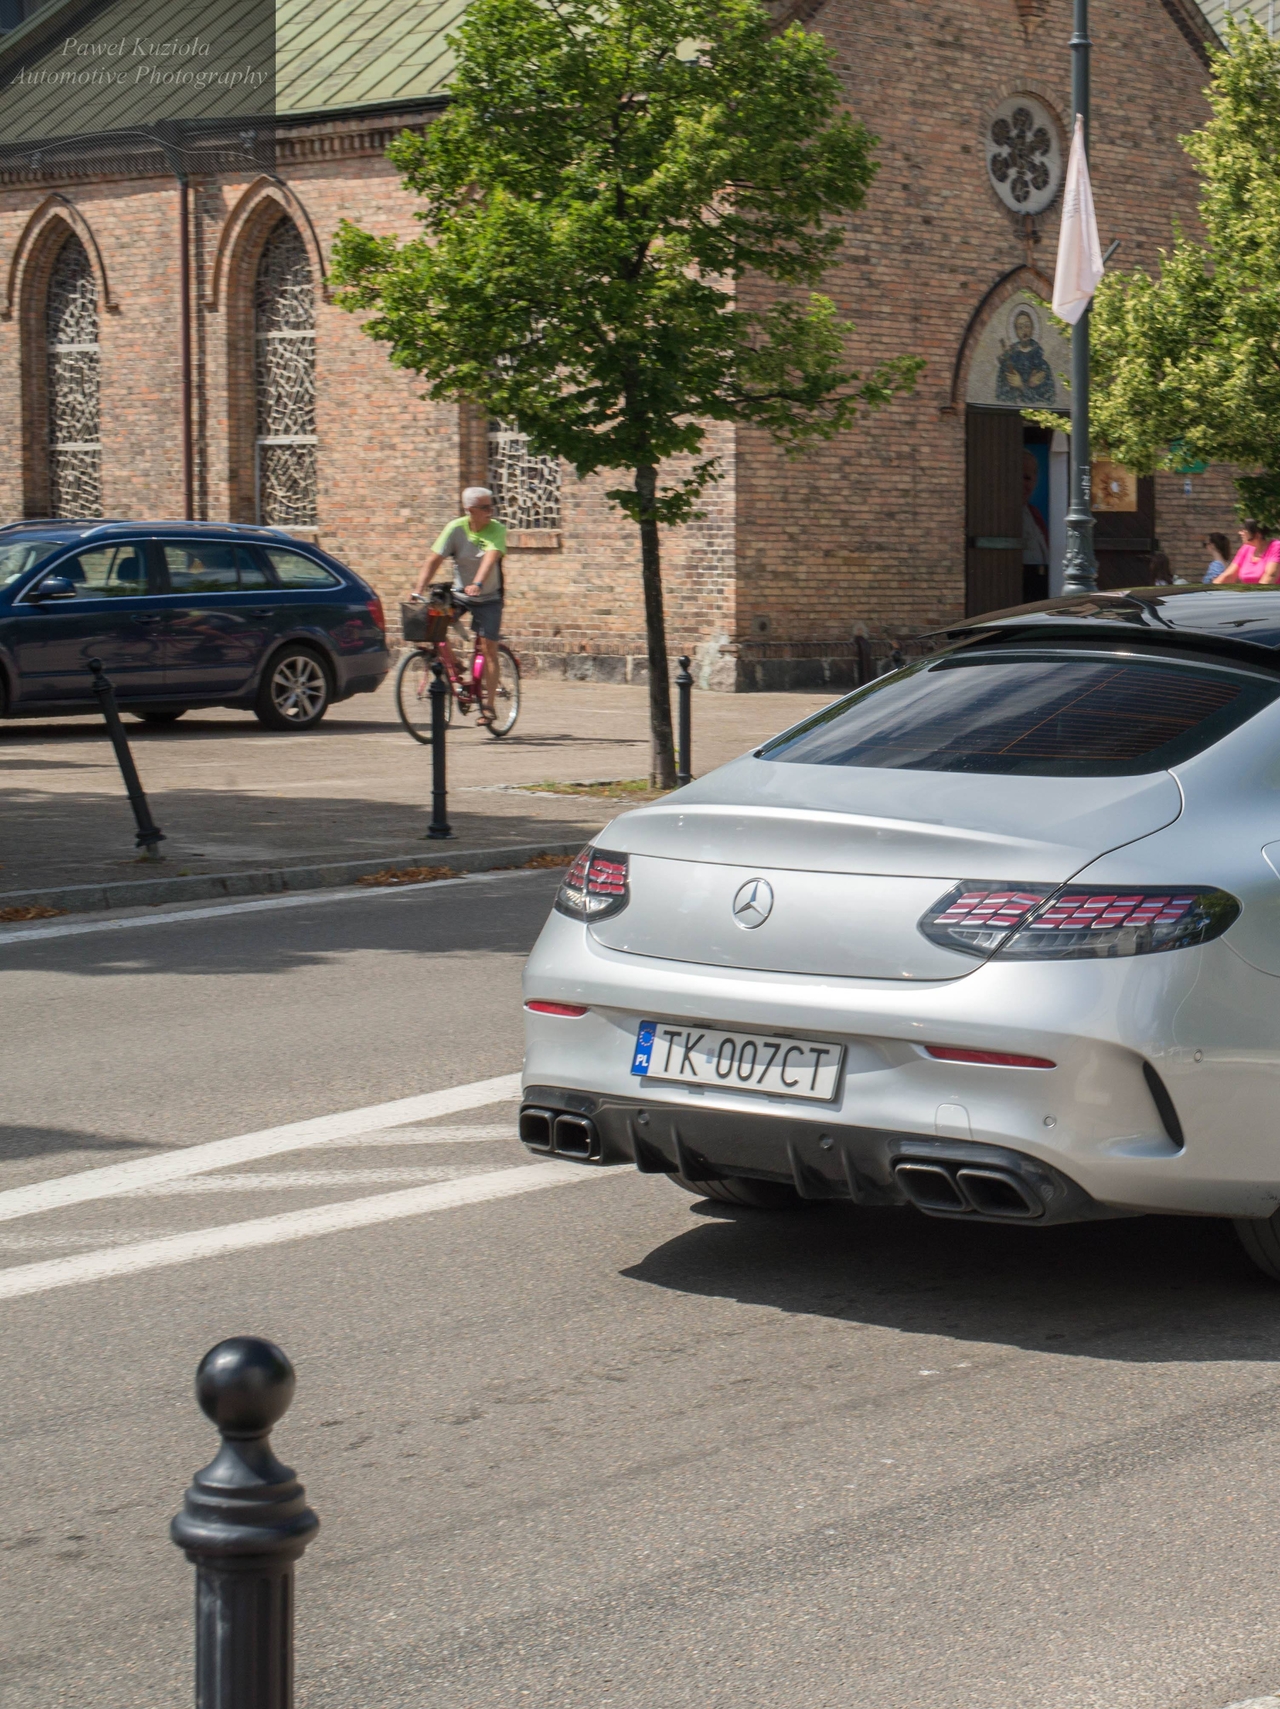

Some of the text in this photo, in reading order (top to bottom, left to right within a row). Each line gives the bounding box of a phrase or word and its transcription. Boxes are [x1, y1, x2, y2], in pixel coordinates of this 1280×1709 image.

[635, 1054, 649, 1067] PL
[663, 1030, 830, 1091] TK 007CT
